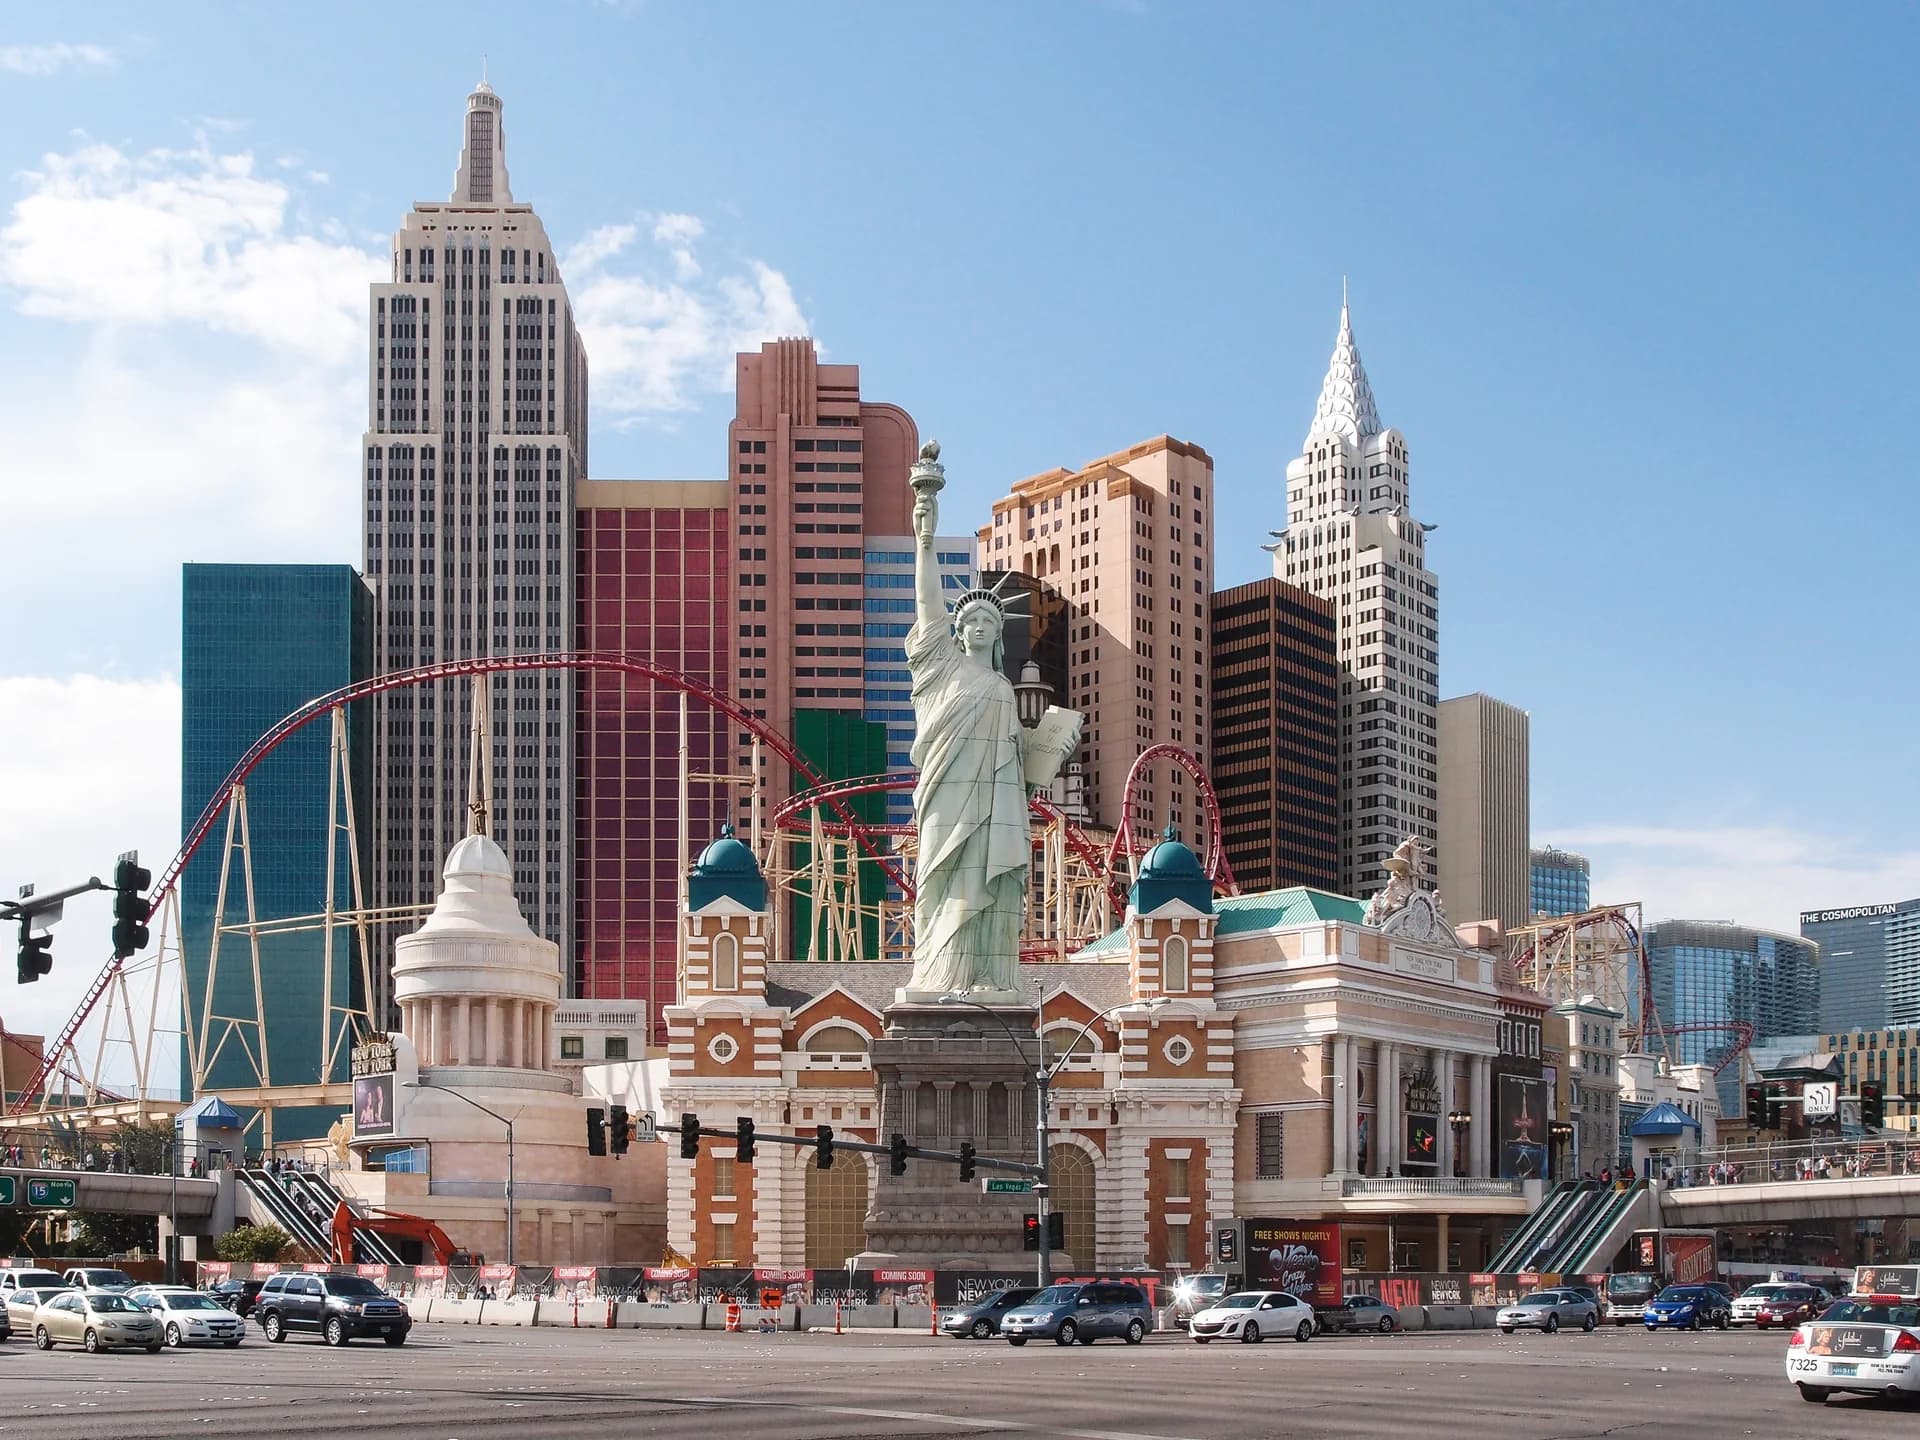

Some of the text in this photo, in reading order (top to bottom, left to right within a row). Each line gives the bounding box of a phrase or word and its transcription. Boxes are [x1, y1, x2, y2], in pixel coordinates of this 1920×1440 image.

[1800, 904, 1896, 924] THE COSMOPOLITAN
[352, 1044, 392, 1061] NEW YORK
[352, 1057, 392, 1075] NEW YORK
[35, 1186, 46, 1196] 15
[1005, 1182, 1021, 1192] Vegas
[1254, 1230, 1331, 1241] FREE SHOWS NIGHTLY
[761, 1270, 806, 1280] COMING SOON
[881, 1271, 926, 1281] COMING SOON
[957, 1278, 1022, 1290] NEW YORK
[1431, 1280, 1461, 1290] NEW YORK
[699, 1287, 719, 1296] NEW
[816, 1288, 868, 1298] NEW YORK
[1431, 1290, 1461, 1300] NEW YORK
[816, 1298, 839, 1306] NEW
[1790, 1358, 1818, 1372] 7325
